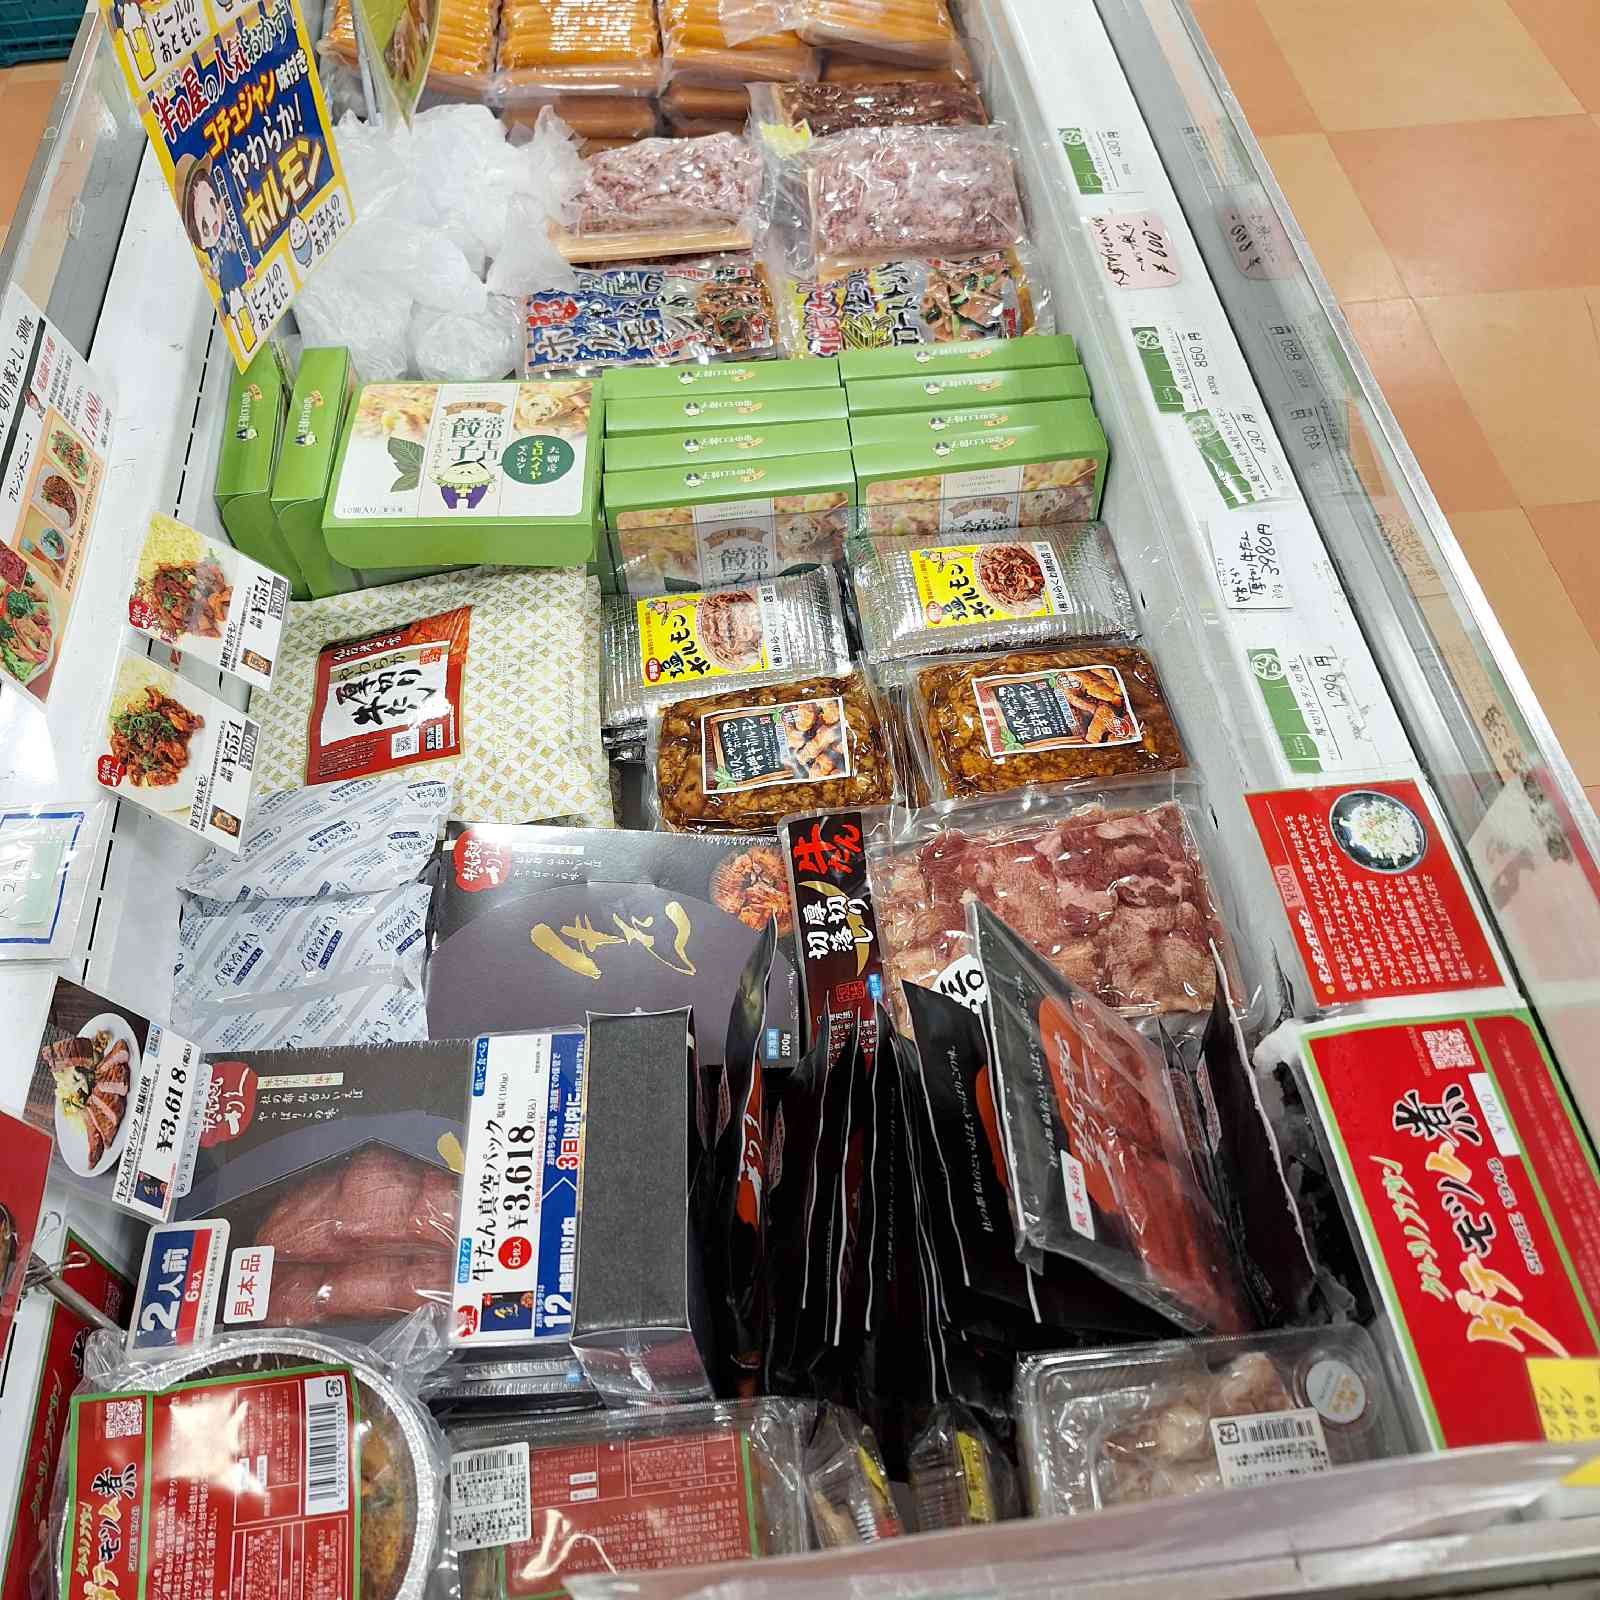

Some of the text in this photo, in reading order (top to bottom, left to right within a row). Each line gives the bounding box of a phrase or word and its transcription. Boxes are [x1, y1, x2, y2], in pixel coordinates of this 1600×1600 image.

[242, 136, 322, 248] ホルモン
[448, 416, 483, 462] 餃子
[529, 439, 545, 480] モロヘイヤ
[250, 575, 271, 621] ¥554
[943, 596, 969, 620] 塩
[949, 564, 994, 618] ホルモン
[661, 651, 685, 679] 塩
[673, 615, 711, 675] ホルモン
[352, 687, 437, 725] 牛たん
[221, 719, 242, 768] ¥554
[793, 822, 863, 876] 牛たん
[803, 895, 870, 926] 厚切り
[156, 1066, 187, 1152] ¥3,618
[115, 1118, 140, 1202] 牛たん真空パック
[503, 1097, 537, 1230] ¥3,618 (税込)
[472, 1120, 504, 1282] 牛たん真空パック
[1487, 1158, 1545, 1276] SINCE 1948
[508, 1238, 522, 1268] 6枚入
[139, 1248, 190, 1333] 2人前
[185, 1269, 203, 1303] 6枚入
[234, 1253, 262, 1317] 見本品
